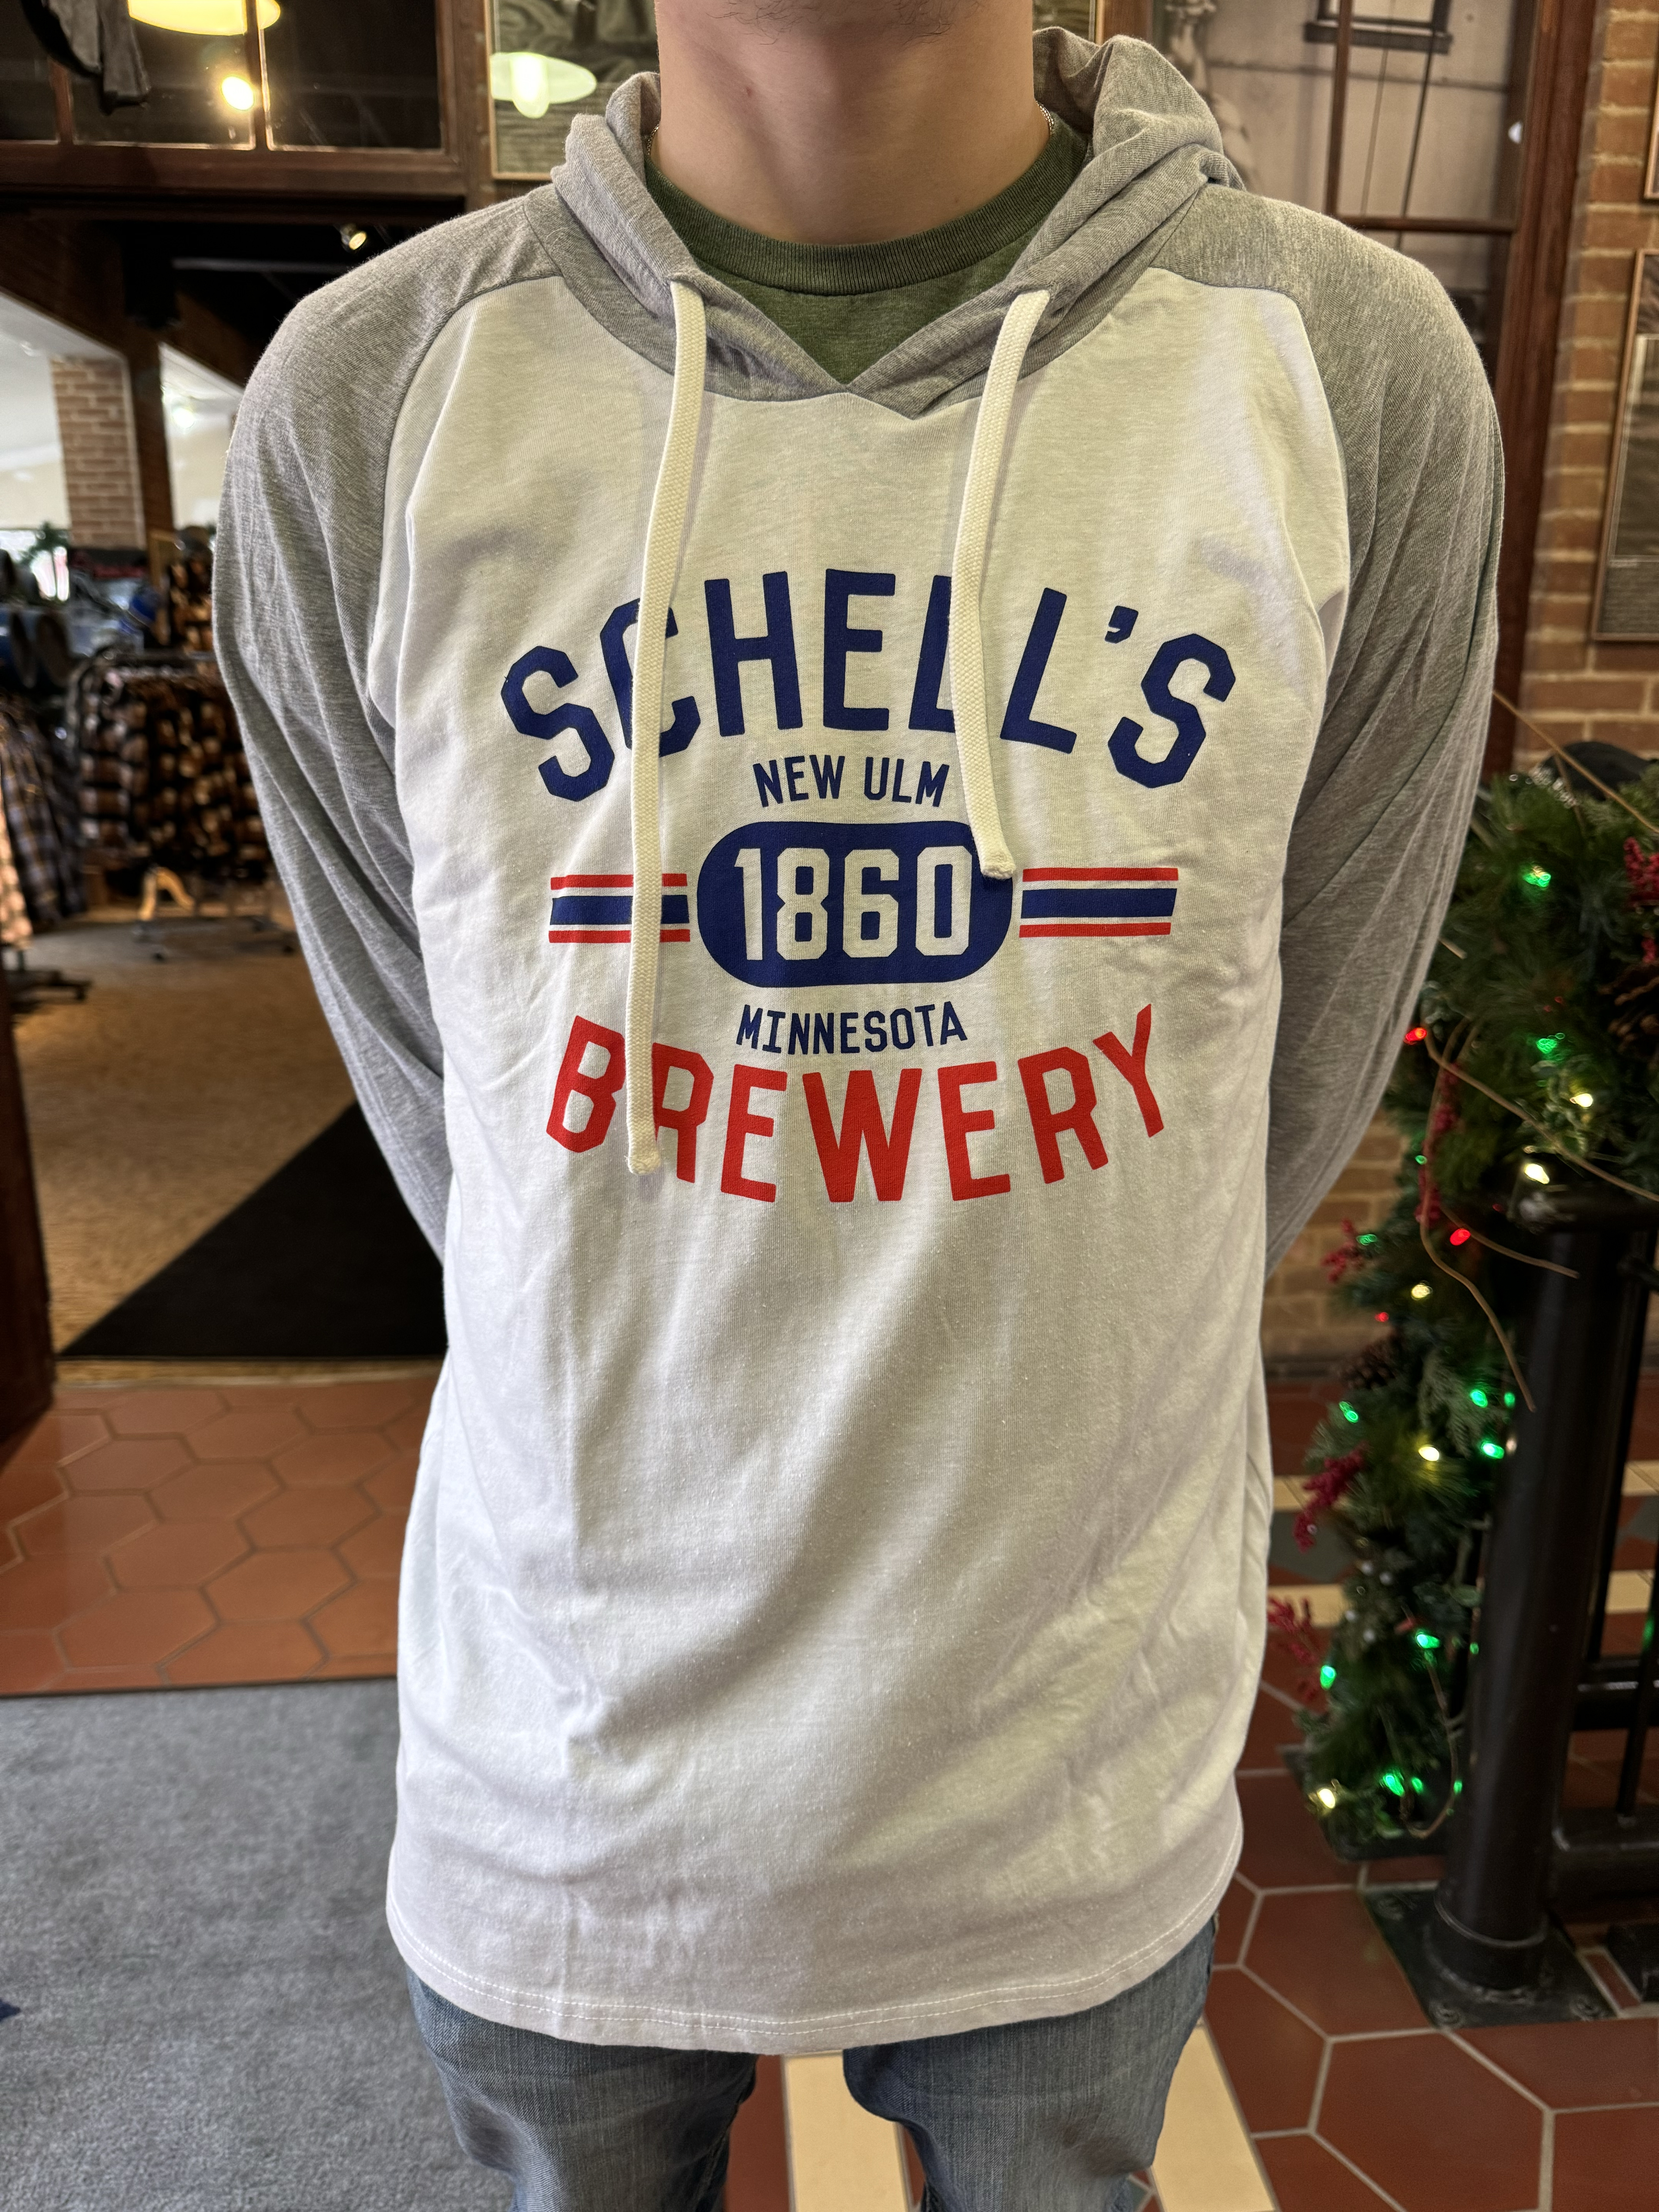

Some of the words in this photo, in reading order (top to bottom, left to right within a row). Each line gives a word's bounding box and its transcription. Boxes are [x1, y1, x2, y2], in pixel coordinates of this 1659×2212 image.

[501, 568, 1236, 802] SCHELL'S
[753, 756, 845, 807] NEW
[864, 757, 950, 808] ULM
[734, 845, 972, 961] 1860
[736, 1001, 967, 1055] MINNESOTA
[546, 1004, 1164, 1203] BREWERY
